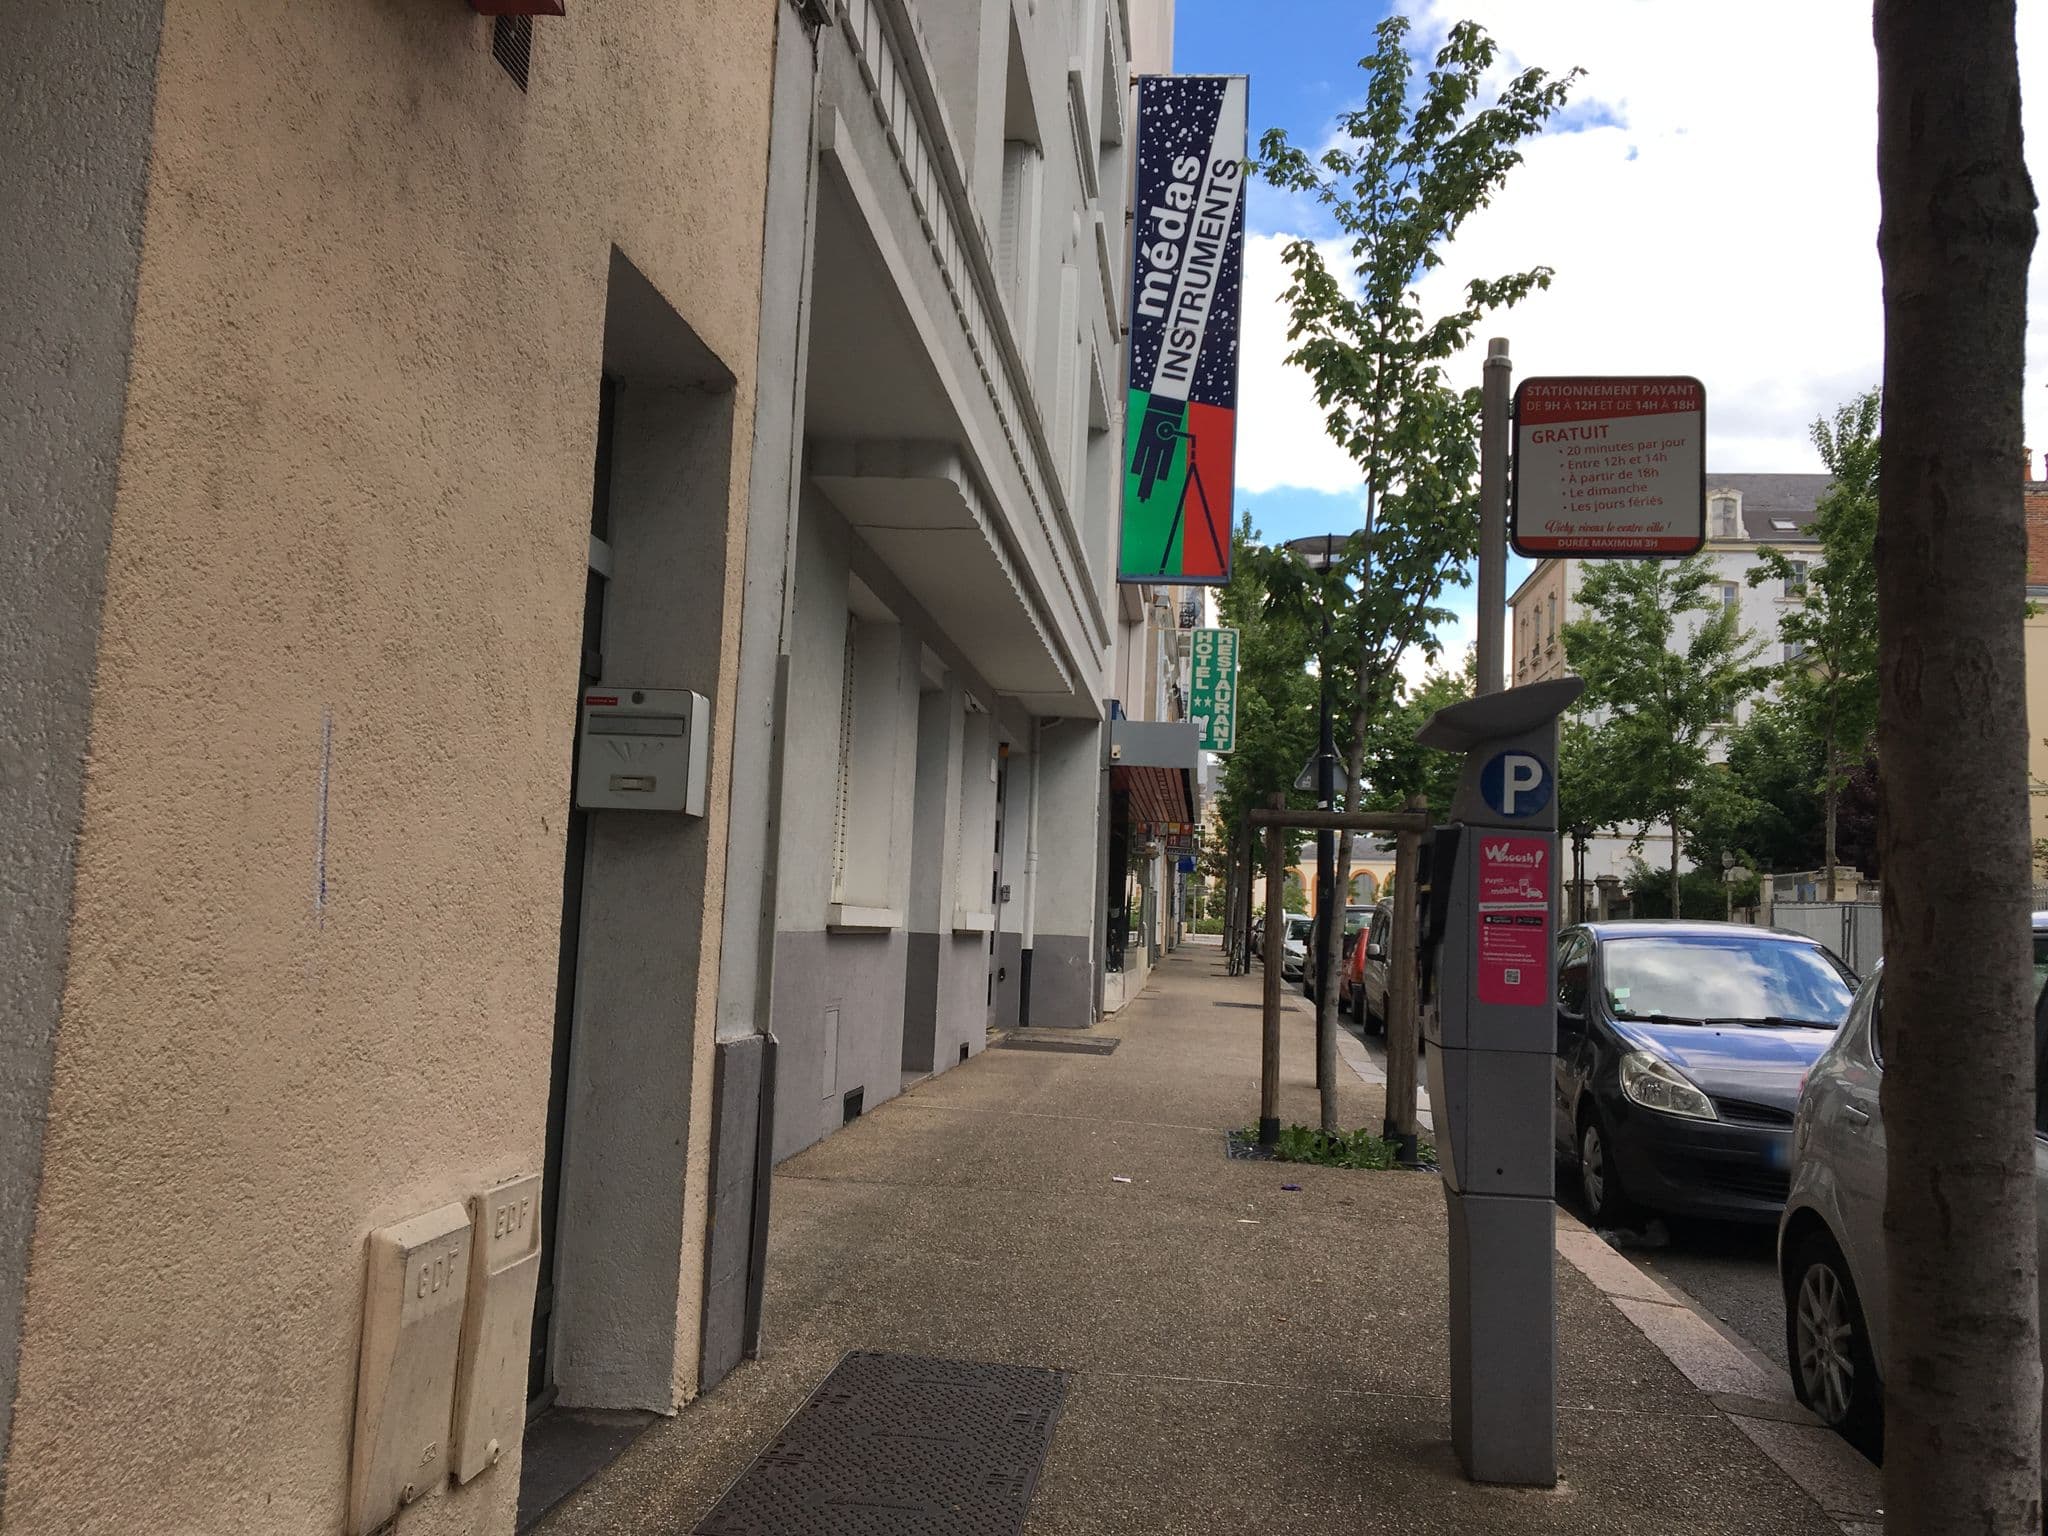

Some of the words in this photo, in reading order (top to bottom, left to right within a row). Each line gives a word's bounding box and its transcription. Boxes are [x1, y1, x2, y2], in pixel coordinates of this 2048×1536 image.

[1137, 154, 1201, 318] médas
[1162, 158, 1239, 382] INSTRUMENTS
[1527, 384, 1640, 397] STATIONNEMENT
[1642, 384, 1696, 396] PAYANT
[1527, 400, 1542, 411] DE
[1544, 400, 1561, 411] 9H
[1574, 400, 1597, 411] 12H
[1600, 400, 1613, 410] ET
[1617, 400, 1632, 410] DE
[1636, 400, 1658, 410] 14H
[1672, 399, 1696, 410] 18H
[1532, 425, 1609, 444] GRATUIT
[1567, 446, 1581, 456] 20
[1584, 442, 1634, 454] minutes
[1637, 440, 1658, 452] par
[1660, 438, 1686, 450] jour
[1567, 459, 1601, 470] Entre
[1605, 456, 1626, 467] 12h
[1629, 455, 1642, 464] et
[1646, 452, 1668, 463] 14h
[1581, 471, 1615, 486] partir
[1618, 470, 1633, 480] de
[1638, 467, 1660, 478] 18h
[1569, 488, 1584, 498] Le
[1587, 482, 1649, 496] dimanche
[1571, 502, 1591, 512] Les
[1593, 499, 1626, 513] jours
[1629, 495, 1664, 508] fériés
[1557, 537, 1591, 548] DURÉE
[1591, 538, 1643, 548] MAXIMUM
[1645, 538, 1659, 548] 3H
[1195, 631, 1214, 690] HOTEL
[1213, 632, 1233, 749] RESTAURANT
[1503, 755, 1543, 814] P
[1485, 842, 1544, 869] Whoosh!
[495, 1196, 529, 1240] EDF
[416, 1248, 459, 1299] GDF
